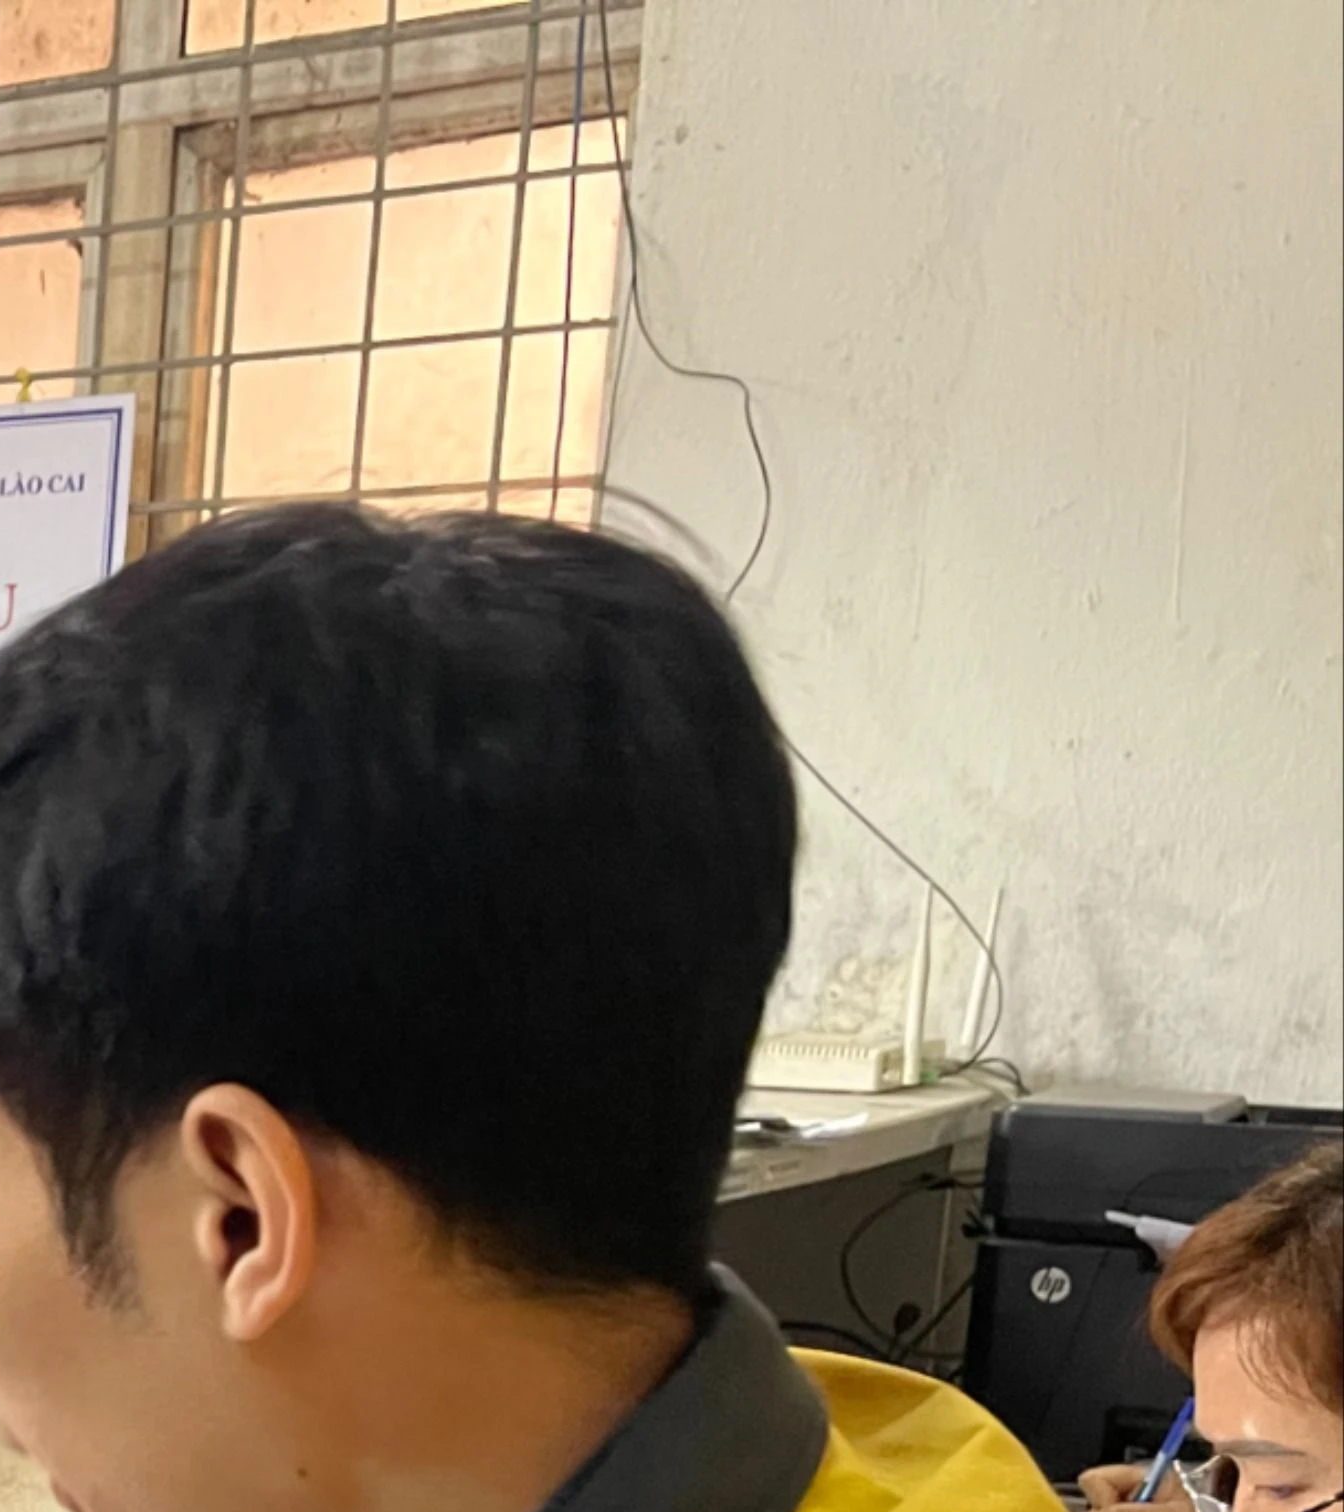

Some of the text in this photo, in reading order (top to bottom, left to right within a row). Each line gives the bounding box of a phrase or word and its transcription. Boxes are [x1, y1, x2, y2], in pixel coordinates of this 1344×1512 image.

[0, 471, 43, 497] LÀO
[48, 472, 86, 494] CAI
[1036, 1268, 1067, 1302] hp
